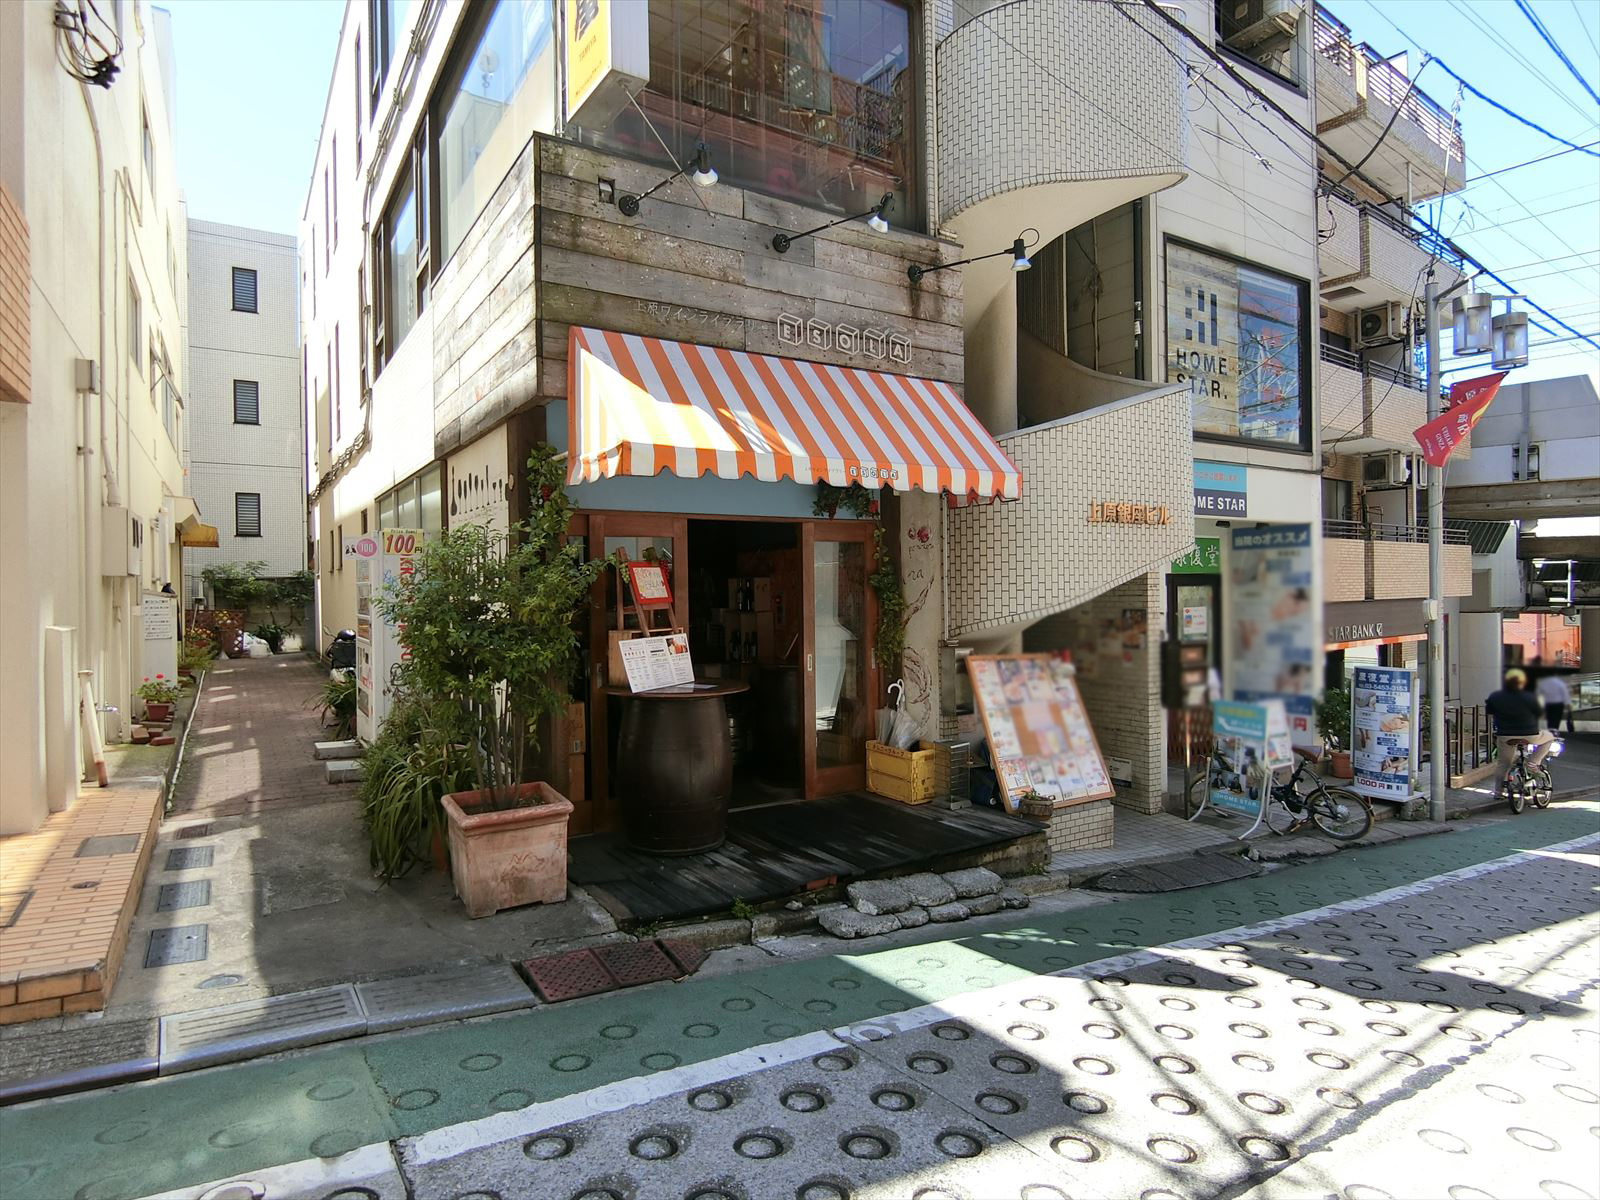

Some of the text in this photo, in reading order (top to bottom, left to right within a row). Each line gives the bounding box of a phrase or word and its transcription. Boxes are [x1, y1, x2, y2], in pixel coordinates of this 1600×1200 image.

[781, 321, 905, 360] ESOLA
[1176, 347, 1228, 376] HOME
[1087, 496, 1173, 526] 上原銀座ビル
[1217, 496, 1246, 511] STAR
[386, 534, 422, 554] 100円
[1328, 623, 1375, 640] STAR BANK
